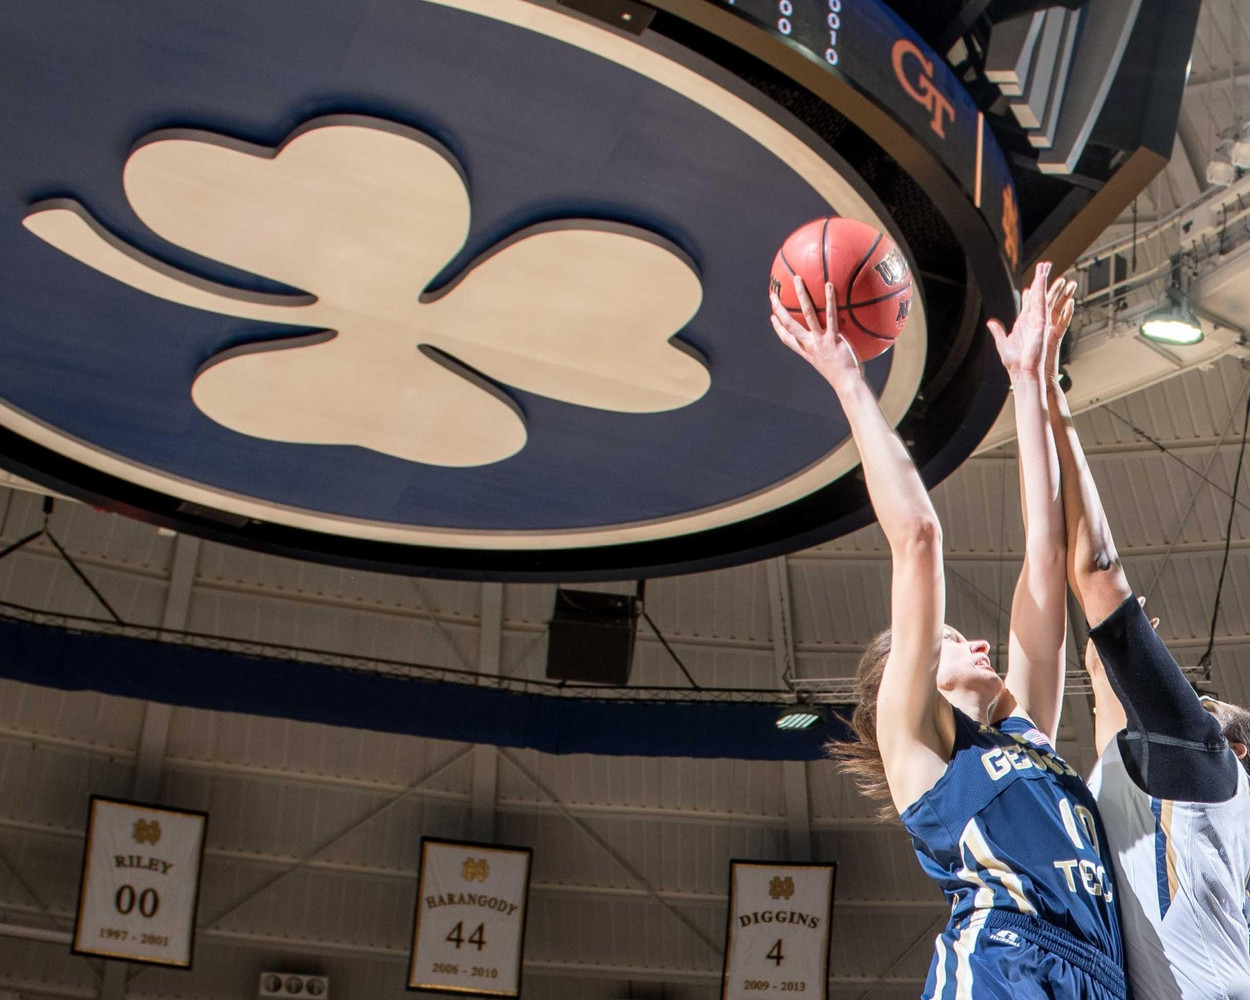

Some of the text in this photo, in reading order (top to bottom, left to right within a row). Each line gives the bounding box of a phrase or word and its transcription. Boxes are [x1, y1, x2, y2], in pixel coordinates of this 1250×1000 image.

[114, 855, 174, 875] RILEY
[1053, 859, 1113, 903] TEC
[115, 884, 159, 918] 00
[426, 892, 518, 916] HARANGODY
[738, 910, 820, 929] DIGGINS
[99, 928, 128, 942] 1997
[140, 933, 169, 947] 2001
[445, 920, 486, 951] 44
[766, 938, 784, 967] 4
[432, 962, 459, 974] 2006
[470, 966, 499, 979] 2010
[743, 980, 770, 991] 2009
[780, 981, 806, 992] 2013
